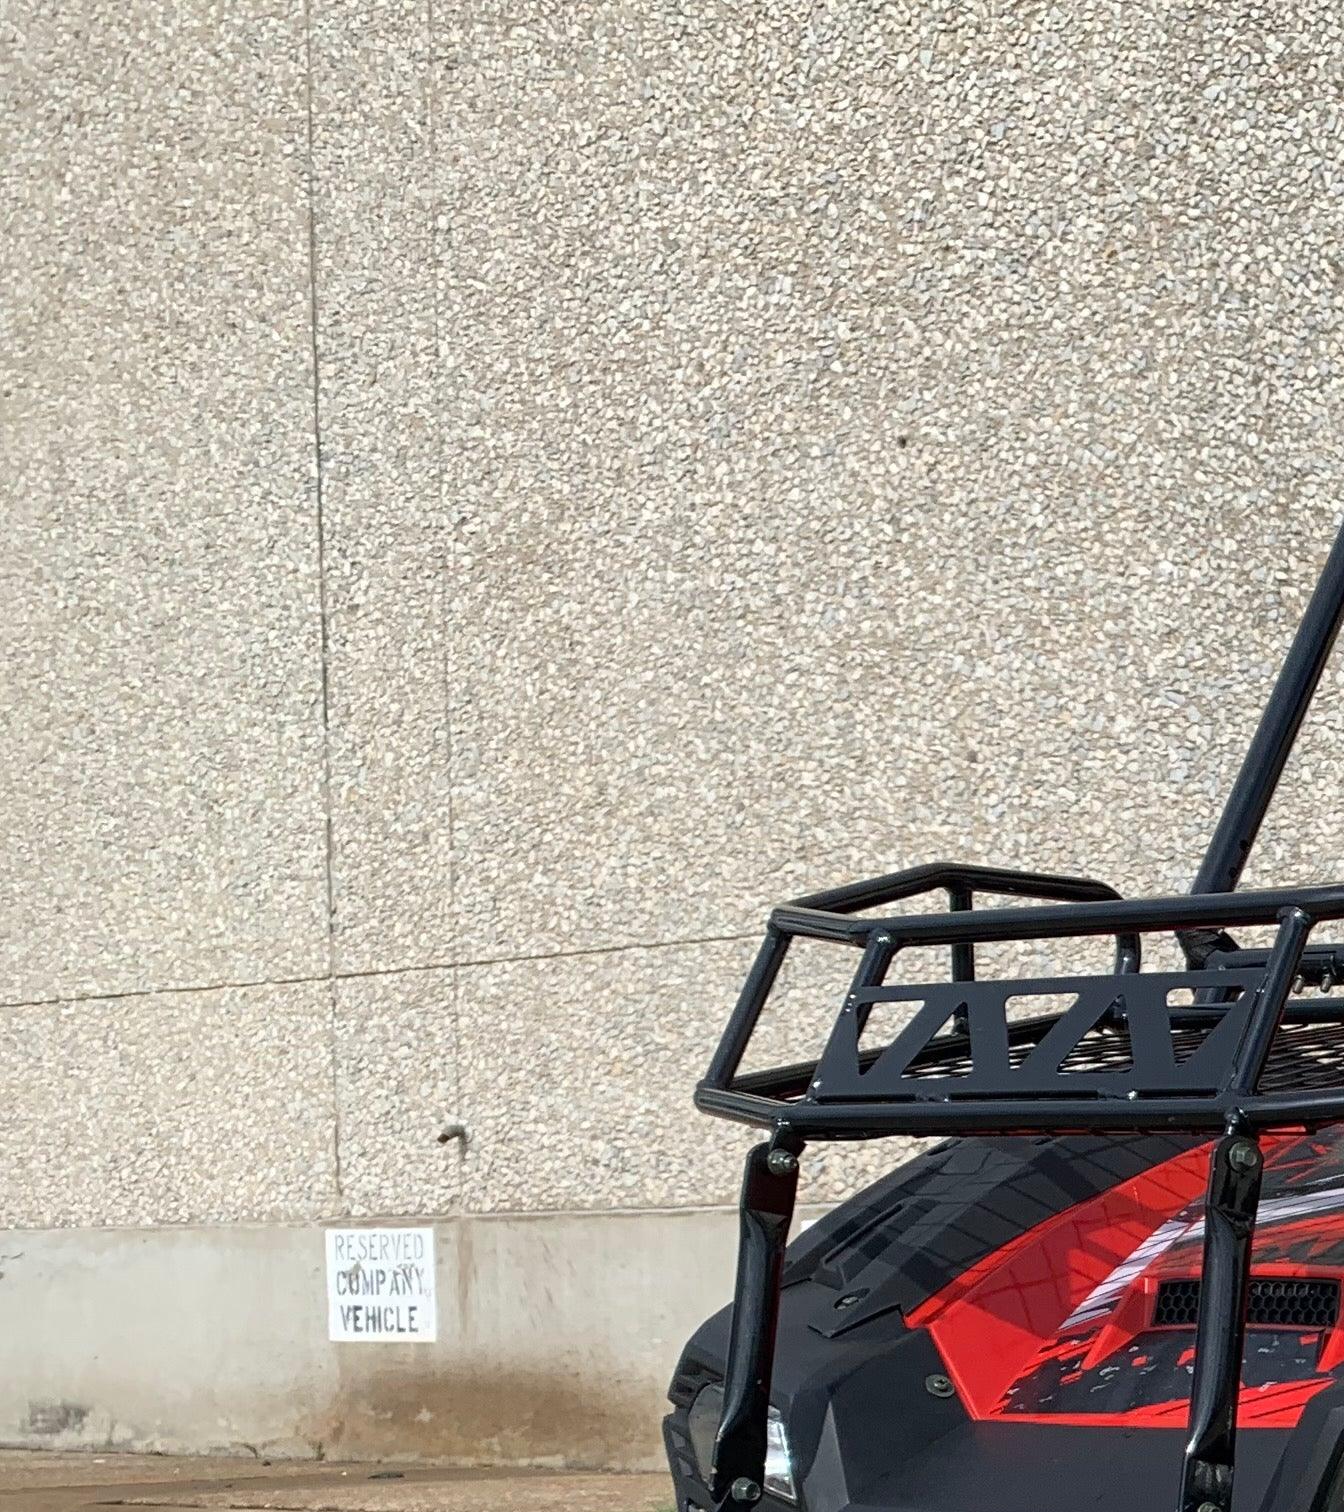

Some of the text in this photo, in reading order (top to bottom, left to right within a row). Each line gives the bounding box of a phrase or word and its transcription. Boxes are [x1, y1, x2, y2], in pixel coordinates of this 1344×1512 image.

[334, 1233, 424, 1260] RESERVED
[336, 1267, 425, 1296] COMPANY
[340, 1304, 419, 1333] VEHICLE
